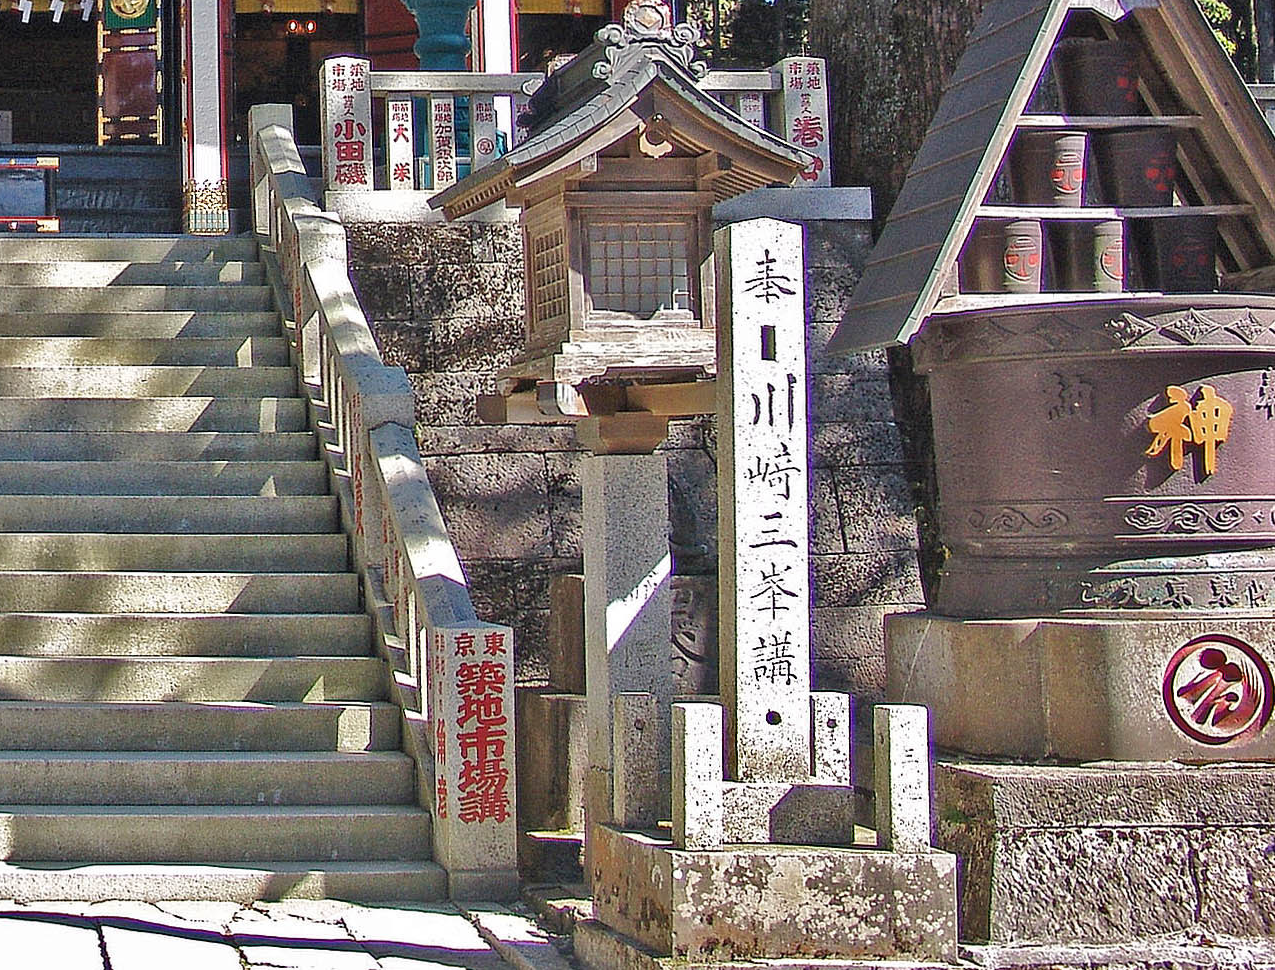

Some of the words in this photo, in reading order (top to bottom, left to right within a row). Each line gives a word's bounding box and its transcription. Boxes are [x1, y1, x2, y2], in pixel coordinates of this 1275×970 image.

[1145, 385, 1233, 475] 神
[456, 659, 510, 824] 築地市場講
